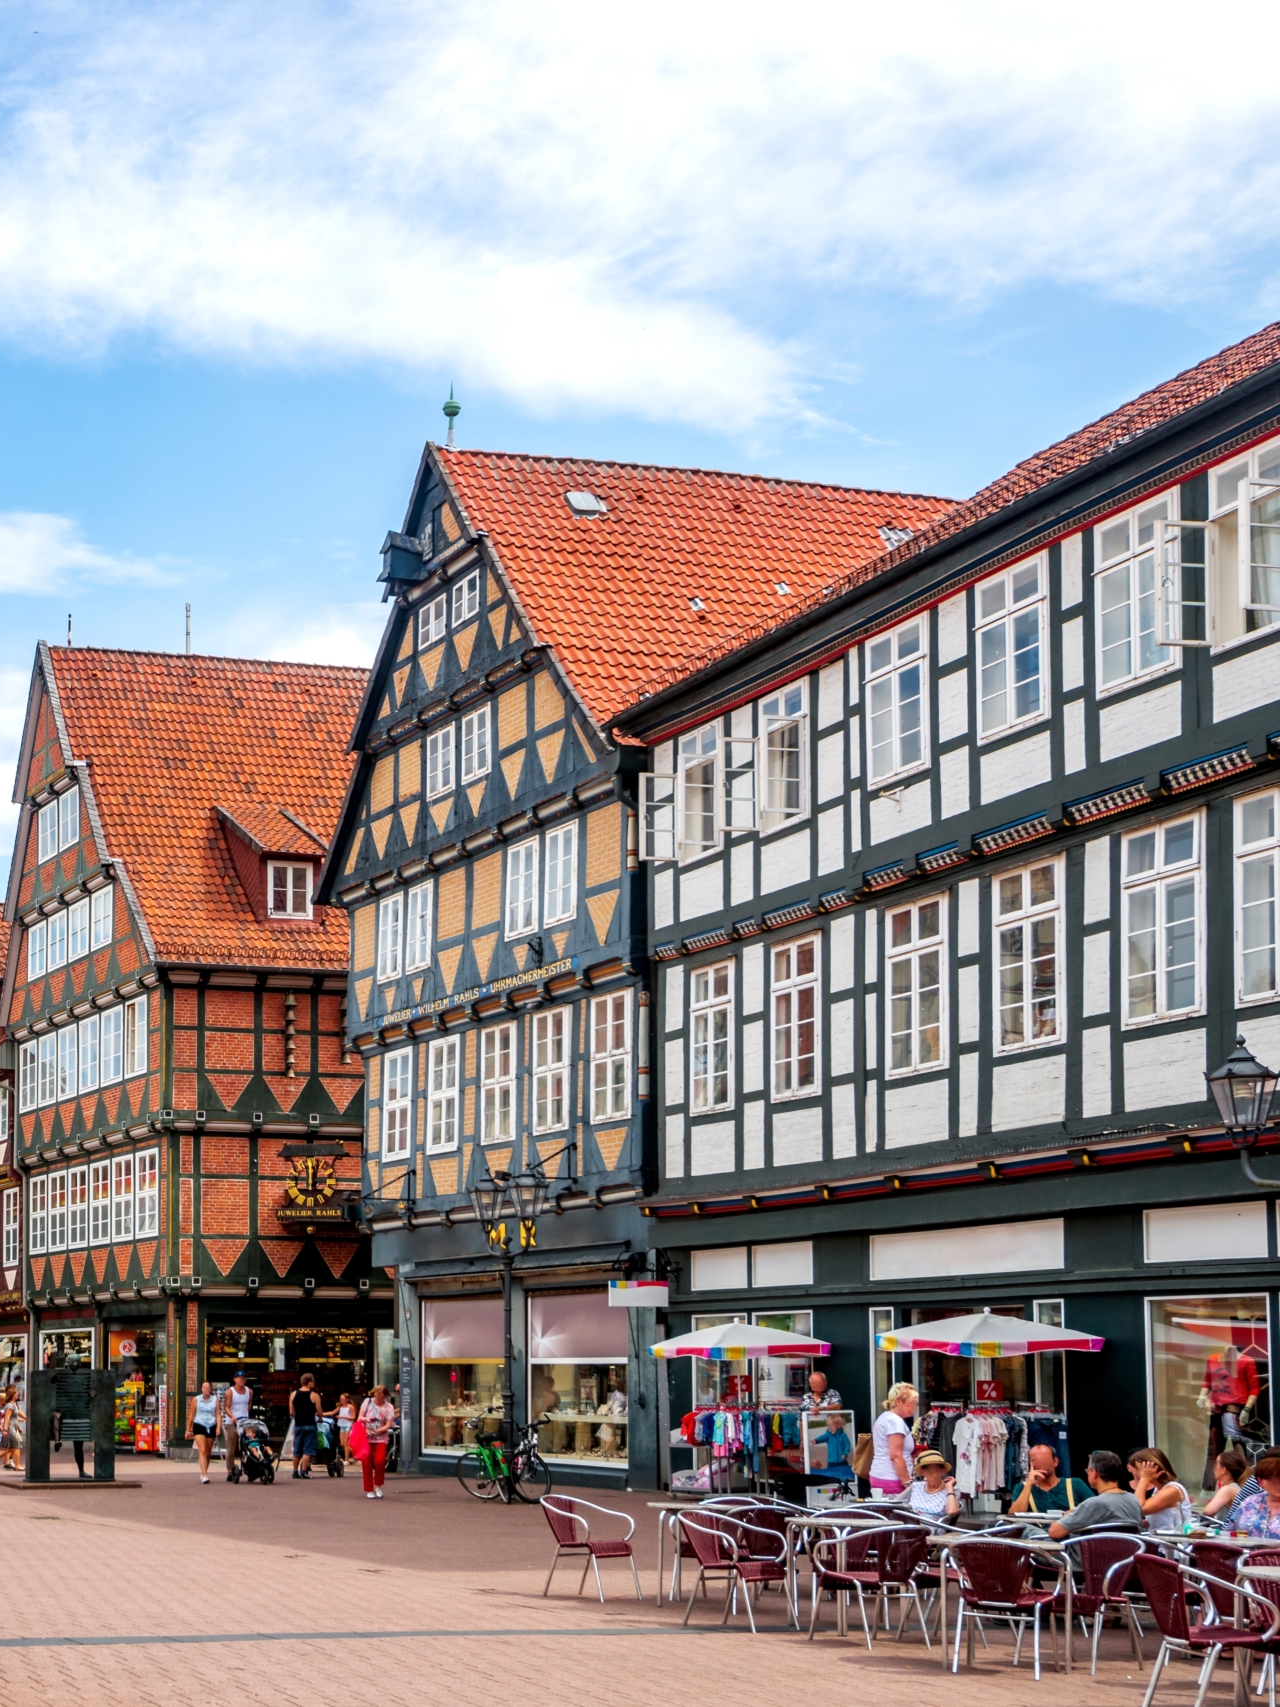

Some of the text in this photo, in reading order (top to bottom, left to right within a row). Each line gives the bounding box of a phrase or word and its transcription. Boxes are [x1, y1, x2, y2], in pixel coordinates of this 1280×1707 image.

[381, 957, 572, 1026] JUWELIER WILHELM RAHLS UHRMACHERMEISTER
